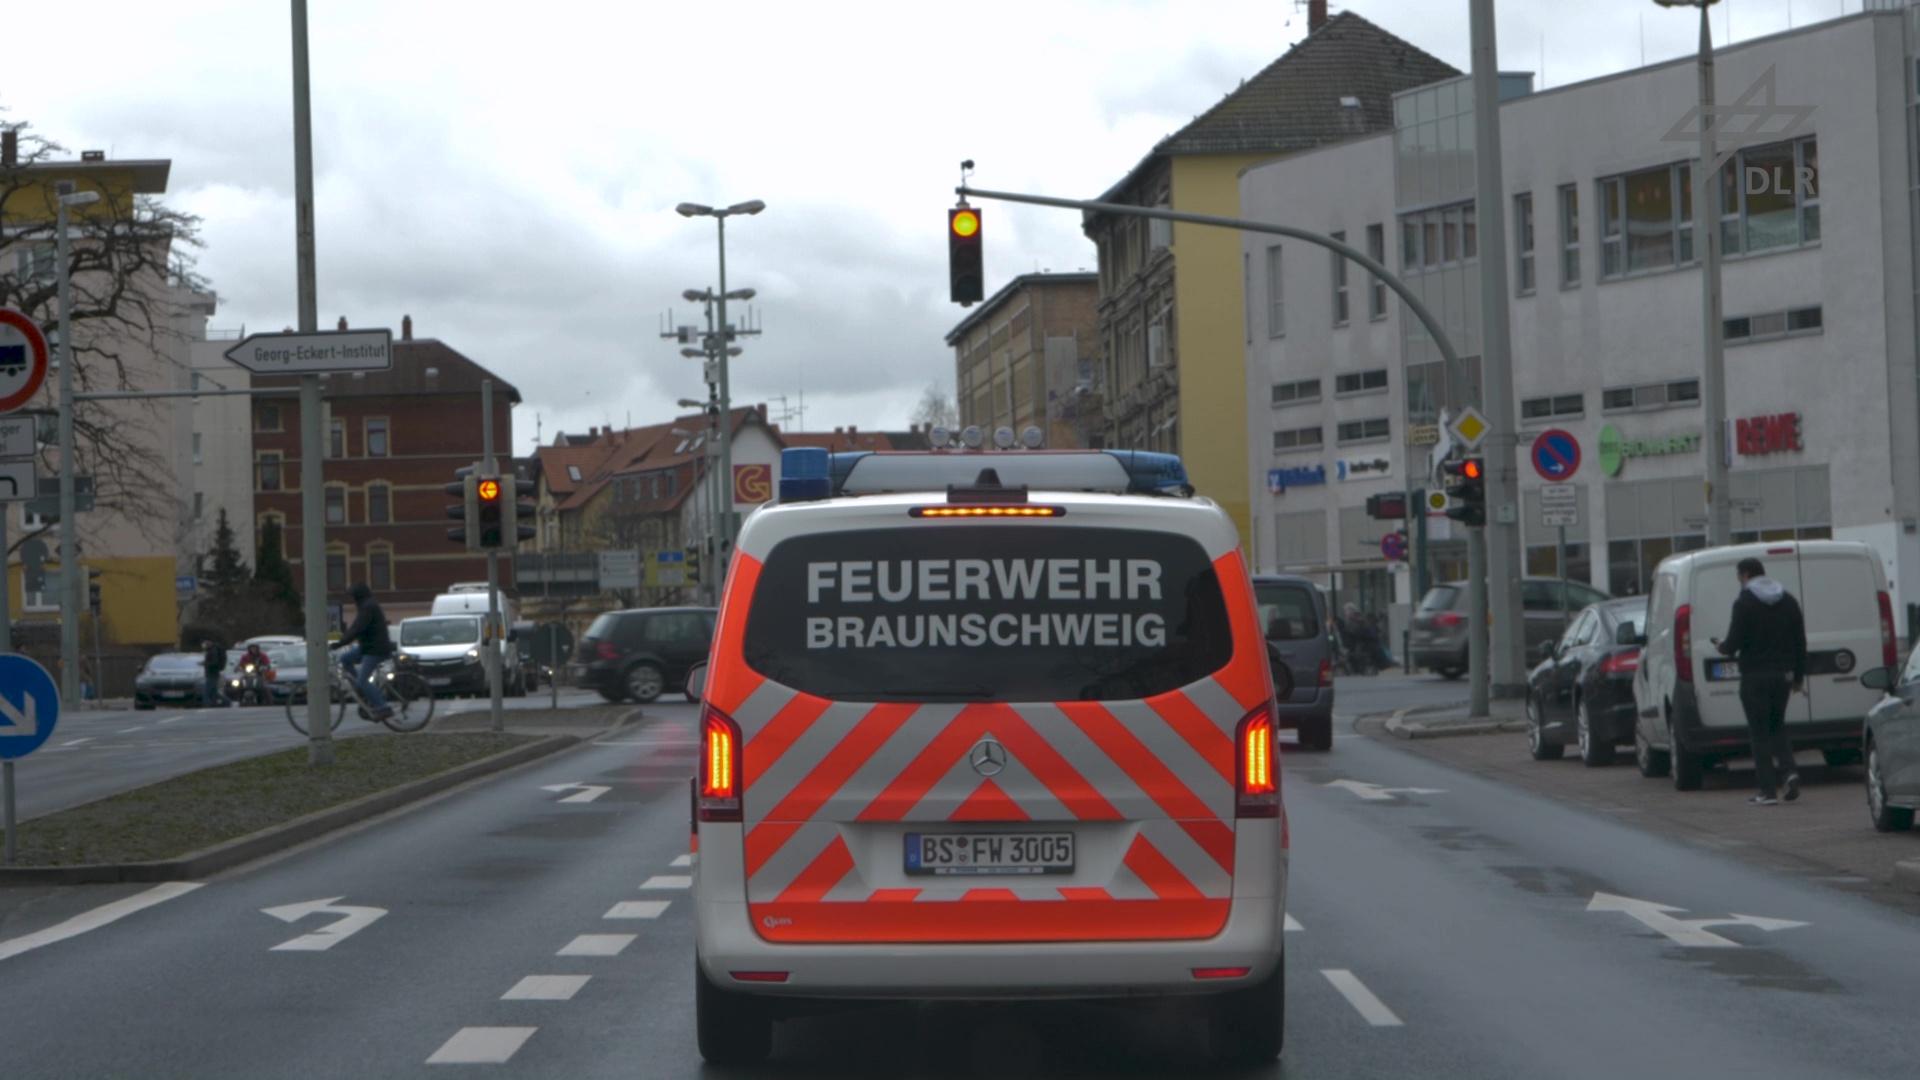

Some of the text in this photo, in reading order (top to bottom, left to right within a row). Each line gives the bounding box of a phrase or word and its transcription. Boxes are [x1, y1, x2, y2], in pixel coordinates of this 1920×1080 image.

[254, 343, 386, 363] Georg-Eckert-Institut
[1736, 411, 1803, 456] REWE
[806, 558, 1163, 603] FEUERWEHR
[806, 613, 1167, 649] BRAUNSCHWEIG
[972, 837, 1003, 864] FW
[1009, 836, 1070, 863] 3005
